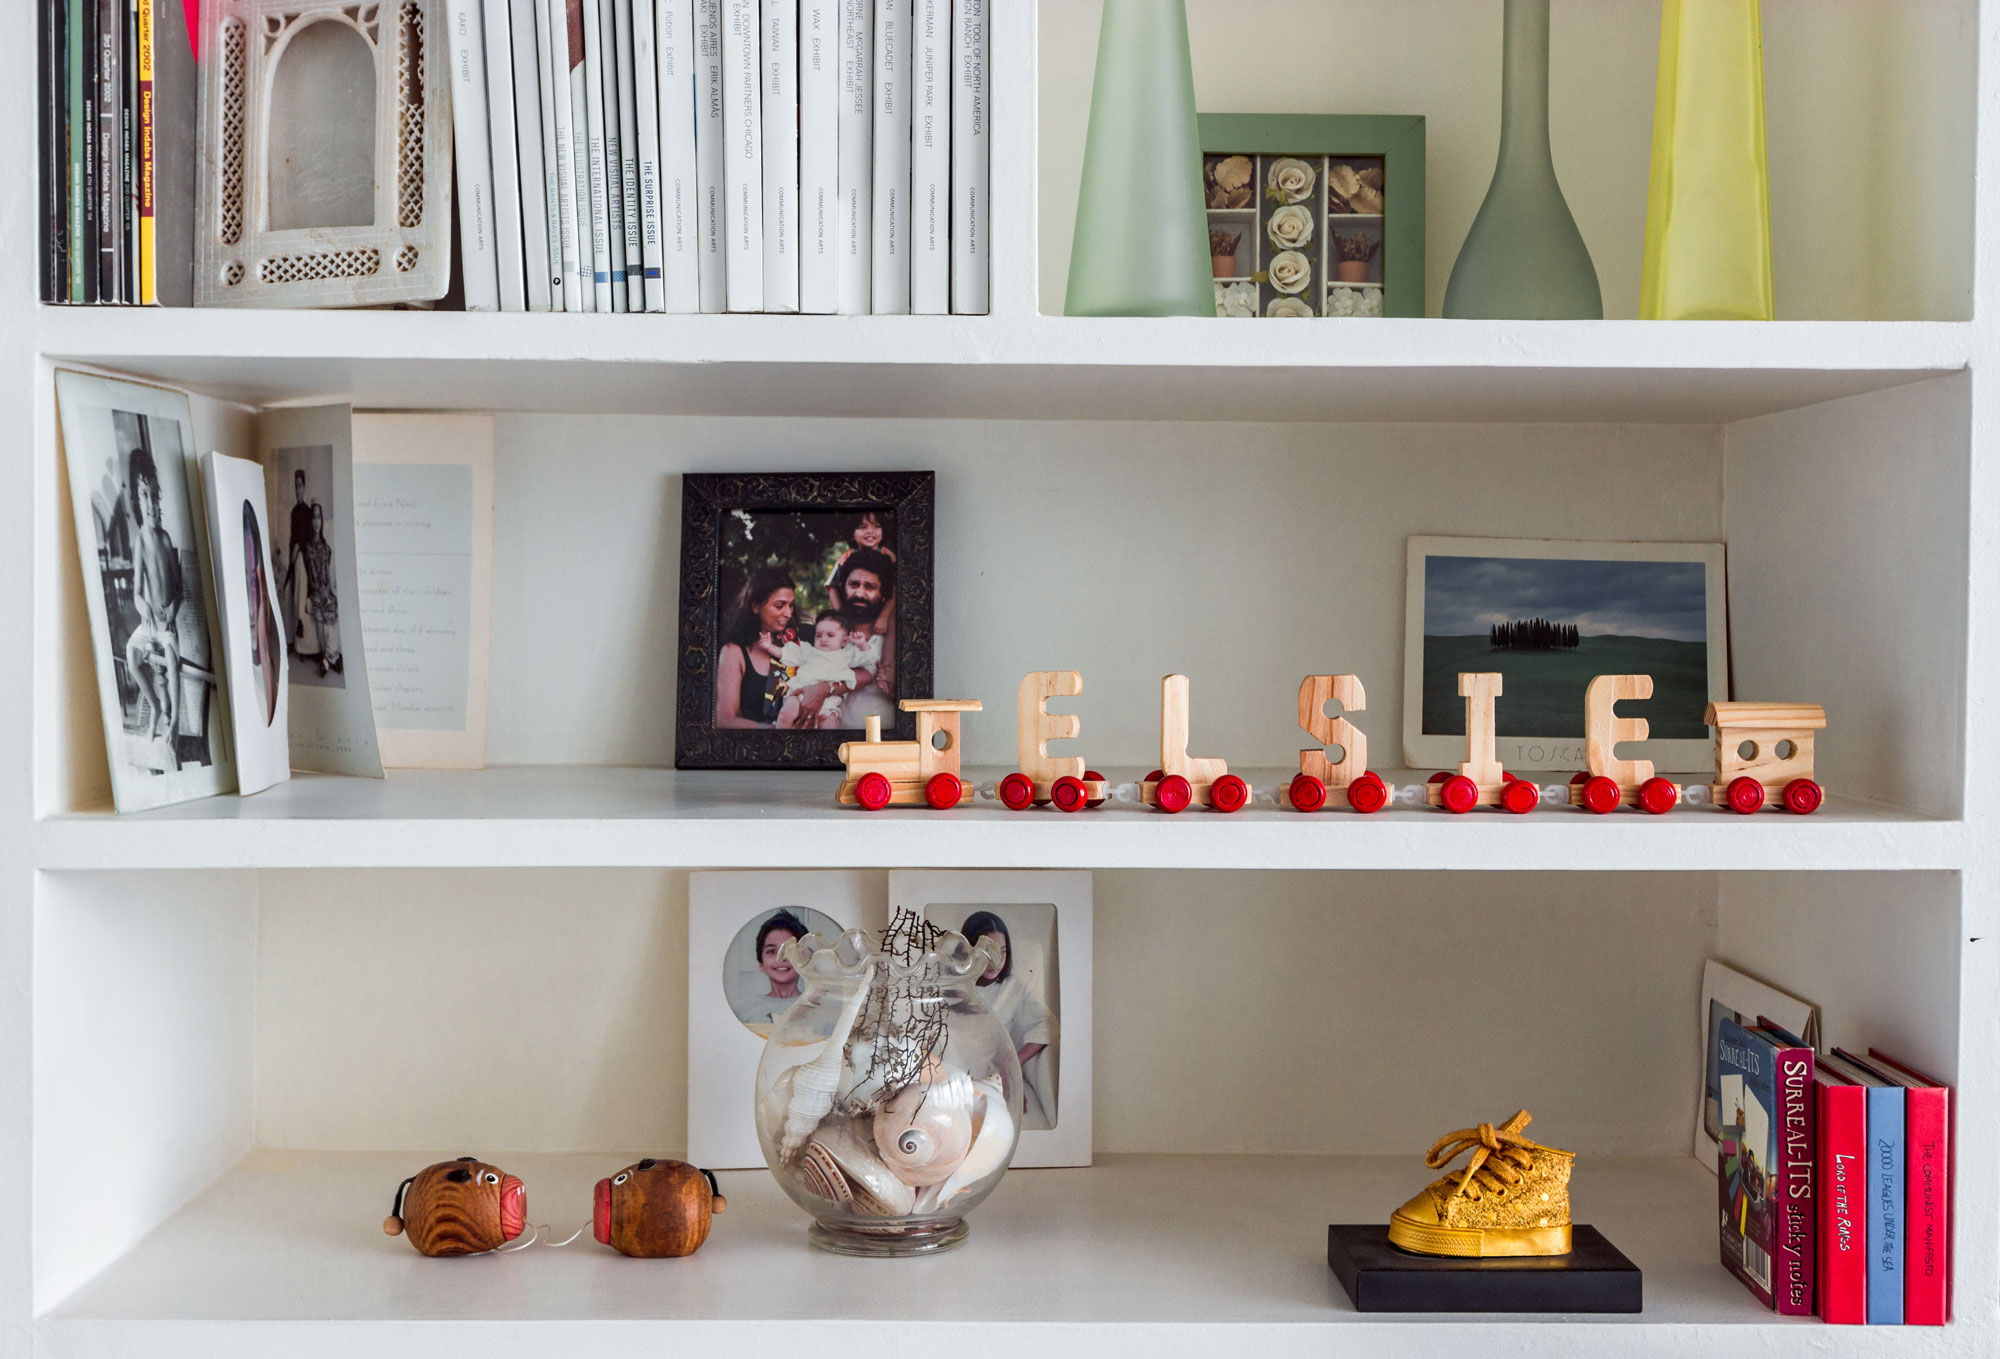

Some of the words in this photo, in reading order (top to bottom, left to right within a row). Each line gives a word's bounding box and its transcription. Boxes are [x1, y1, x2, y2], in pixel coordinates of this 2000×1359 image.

[143, 8, 151, 42] Quarter
[458, 12, 467, 36] KAKO
[665, 11, 673, 39] Potion
[708, 0, 717, 29] UENOS
[733, 3, 741, 36] EXHIBIT
[812, 9, 821, 30] WAX
[925, 0, 934, 38] KERMAN
[103, 33, 111, 48] 3rd
[700, 24, 709, 57] EXHIBIT
[709, 31, 718, 57] AIRES
[742, 14, 751, 70] DOWNTOWN
[771, 17, 780, 51] TAIWAN
[885, 21, 893, 72] BLUECADET
[964, 17, 972, 49] RANCH
[973, 22, 981, 45] TOOL
[103, 49, 111, 81] Quarter
[143, 44, 151, 71] 2002
[460, 49, 470, 83] EXHIBIT
[665, 46, 675, 77] Exhibit
[812, 37, 821, 71] EXHIBIT
[925, 45, 934, 83] JUNIPER
[973, 47, 981, 60] OF
[710, 65, 719, 85] ERIK
[771, 62, 780, 96] EXHIBIT
[846, 60, 854, 94] EXHIBIT
[963, 54, 972, 88] EXHIBIT
[973, 62, 981, 93] NORTH
[103, 82, 111, 104] 2002
[142, 91, 152, 124] Design
[710, 86, 721, 119] ALMÅS
[743, 72, 752, 117] PARTNERS
[854, 83, 863, 114] JESSEE
[885, 82, 893, 115] EXHIBIT
[925, 84, 934, 108] PARK
[924, 115, 933, 148] EXHIBIT
[973, 95, 981, 136] AMERICA
[101, 132, 110, 161] Design
[143, 126, 152, 159] Indaba
[556, 127, 565, 141] THE
[574, 132, 583, 146] THE
[591, 137, 600, 153] THE
[608, 137, 618, 156] NEW
[744, 118, 753, 159] CHICAGO
[558, 143, 566, 160] NEW
[625, 157, 634, 174] THE
[102, 163, 110, 192] Indaba
[142, 161, 152, 208] Magazine
[558, 163, 568, 191] VISUAL
[575, 149, 586, 204] ILLUSTRATION
[609, 159, 620, 190] VISUAL
[644, 161, 653, 176] THE
[592, 156, 603, 226] INTERNATIONAL
[626, 177, 636, 218] IDENTITY
[645, 179, 655, 218] SURPRISE
[674, 178, 682, 235] COMMUNICATION
[101, 193, 110, 233] Magazine
[474, 184, 483, 234] COMMUNICATION
[560, 193, 570, 225] ARTISTS
[578, 206, 588, 228] ISSUE
[611, 193, 622, 230] ARTISTS
[562, 227, 571, 250] ISSUE
[595, 229, 604, 255] ISSUE
[627, 221, 638, 247] ISSUE
[646, 221, 656, 245] ISSUE
[1516, 744, 1585, 763] TOSCA
[1719, 1039, 1760, 1076] SURREAL-ITS
[1783, 1060, 1814, 1200] SURREAL-ITS
[1879, 1139, 1895, 1170] 20000
[1922, 1140, 1936, 1160] THE
[1835, 1153, 1856, 1182] LORD
[1836, 1195, 1848, 1215] THE
[1881, 1173, 1895, 1211] LEAGUES
[1923, 1163, 1937, 1221] COMMUNIST
[1782, 1203, 1808, 1257] sticky
[1837, 1216, 1852, 1251] RINGS
[1883, 1213, 1896, 1240] UNDER
[1881, 1241, 1894, 1253] THE
[1924, 1223, 1934, 1277] MANIFESTO
[1881, 1256, 1894, 1272] SEA
[1787, 1260, 1809, 1307] notes
